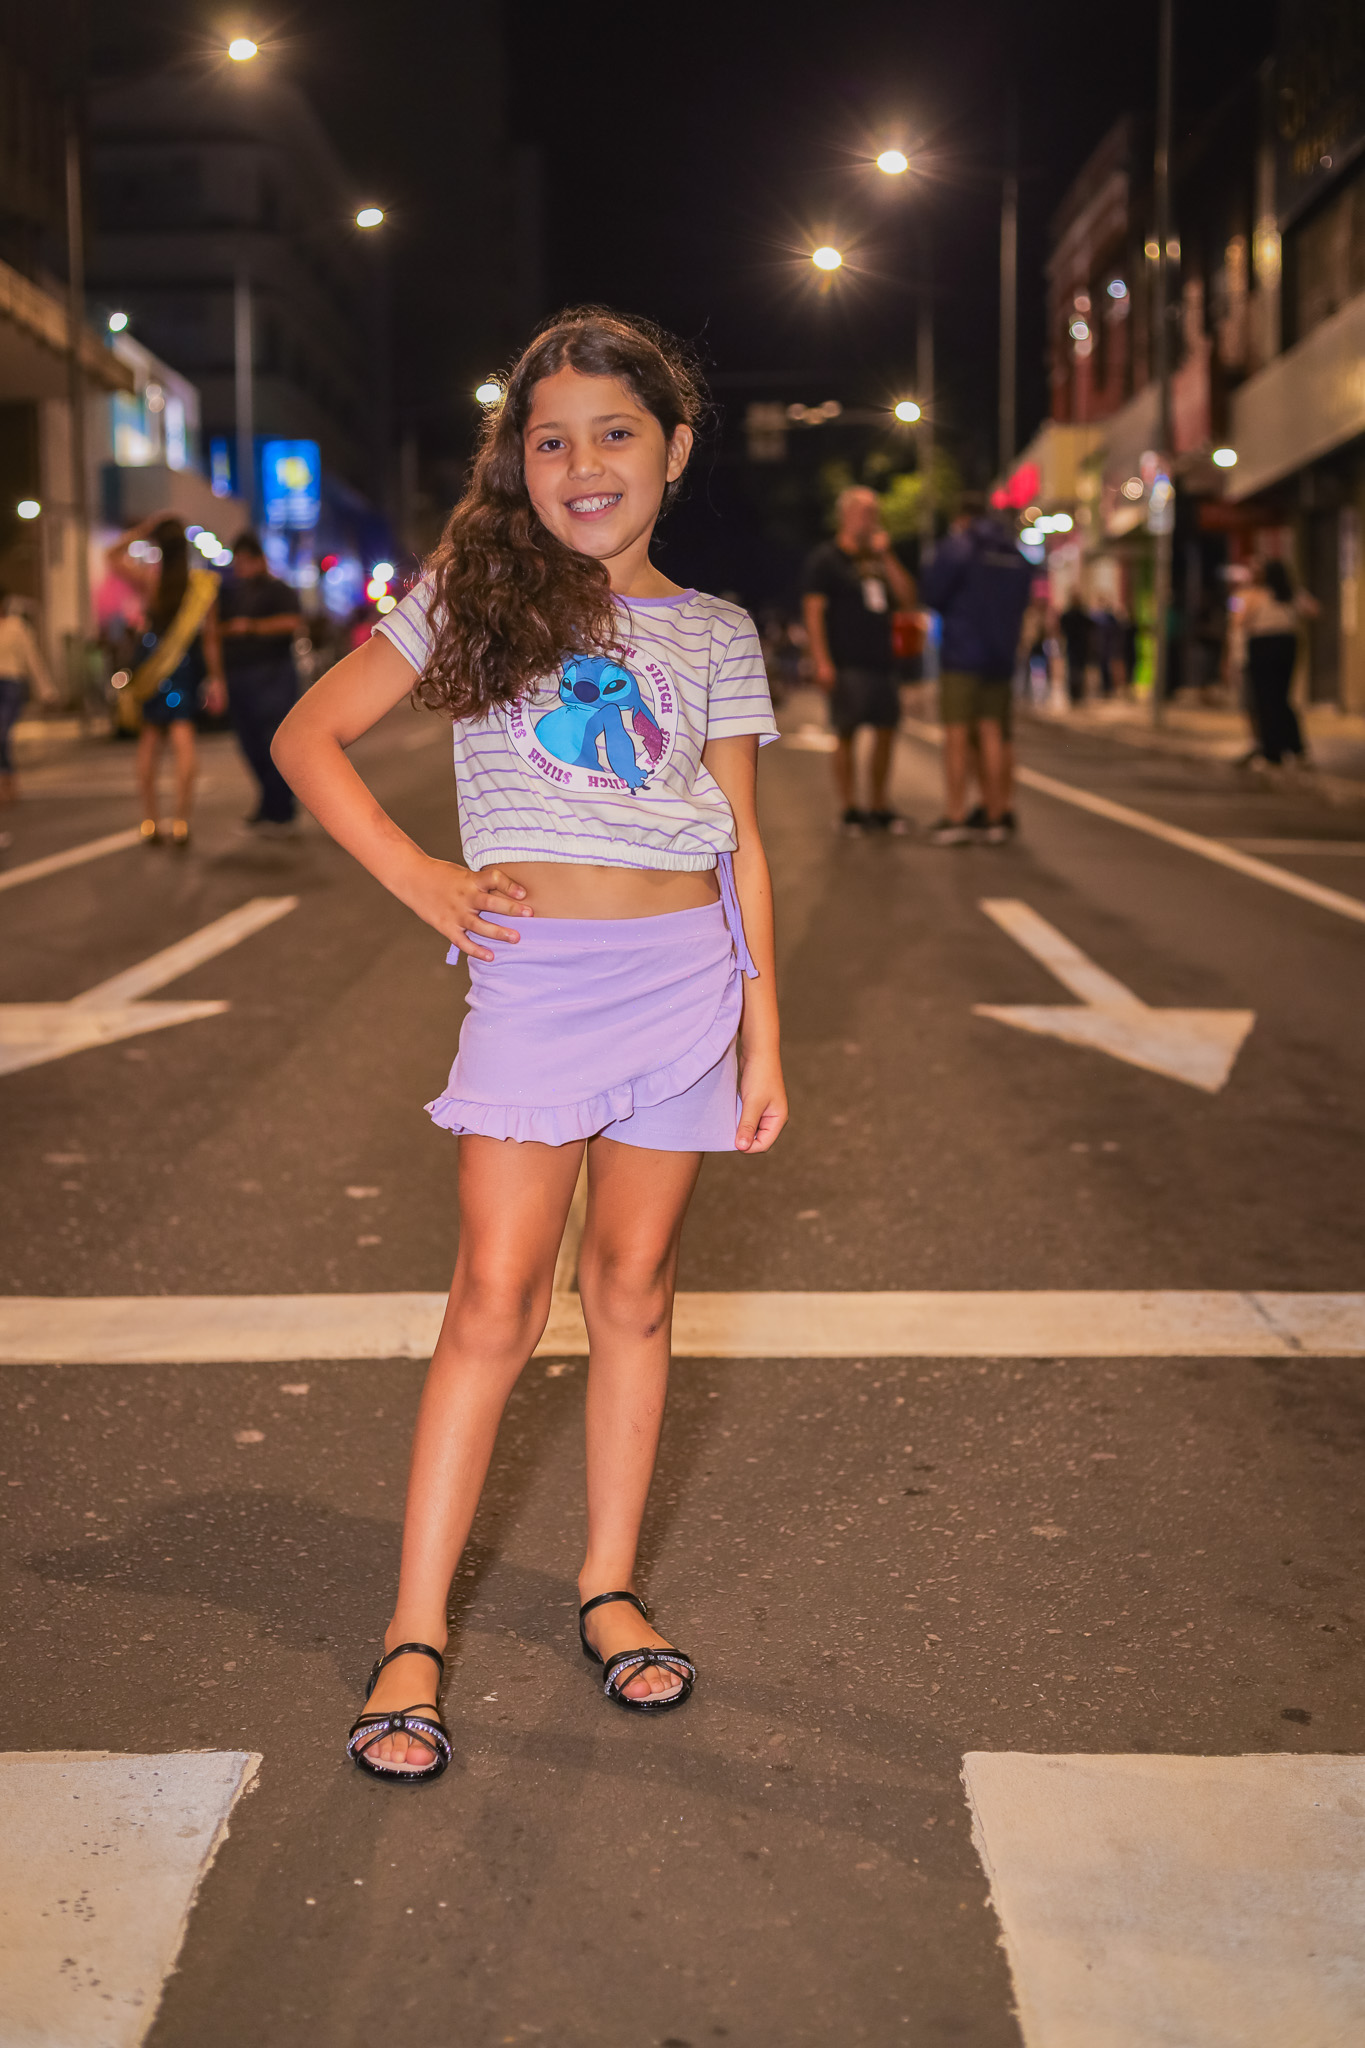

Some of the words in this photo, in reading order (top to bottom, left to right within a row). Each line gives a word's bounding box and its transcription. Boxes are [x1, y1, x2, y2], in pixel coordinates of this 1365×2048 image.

[645, 663, 673, 714] STITCH
[528, 747, 573, 784] STITCH
[587, 775, 629, 790] TITCH
